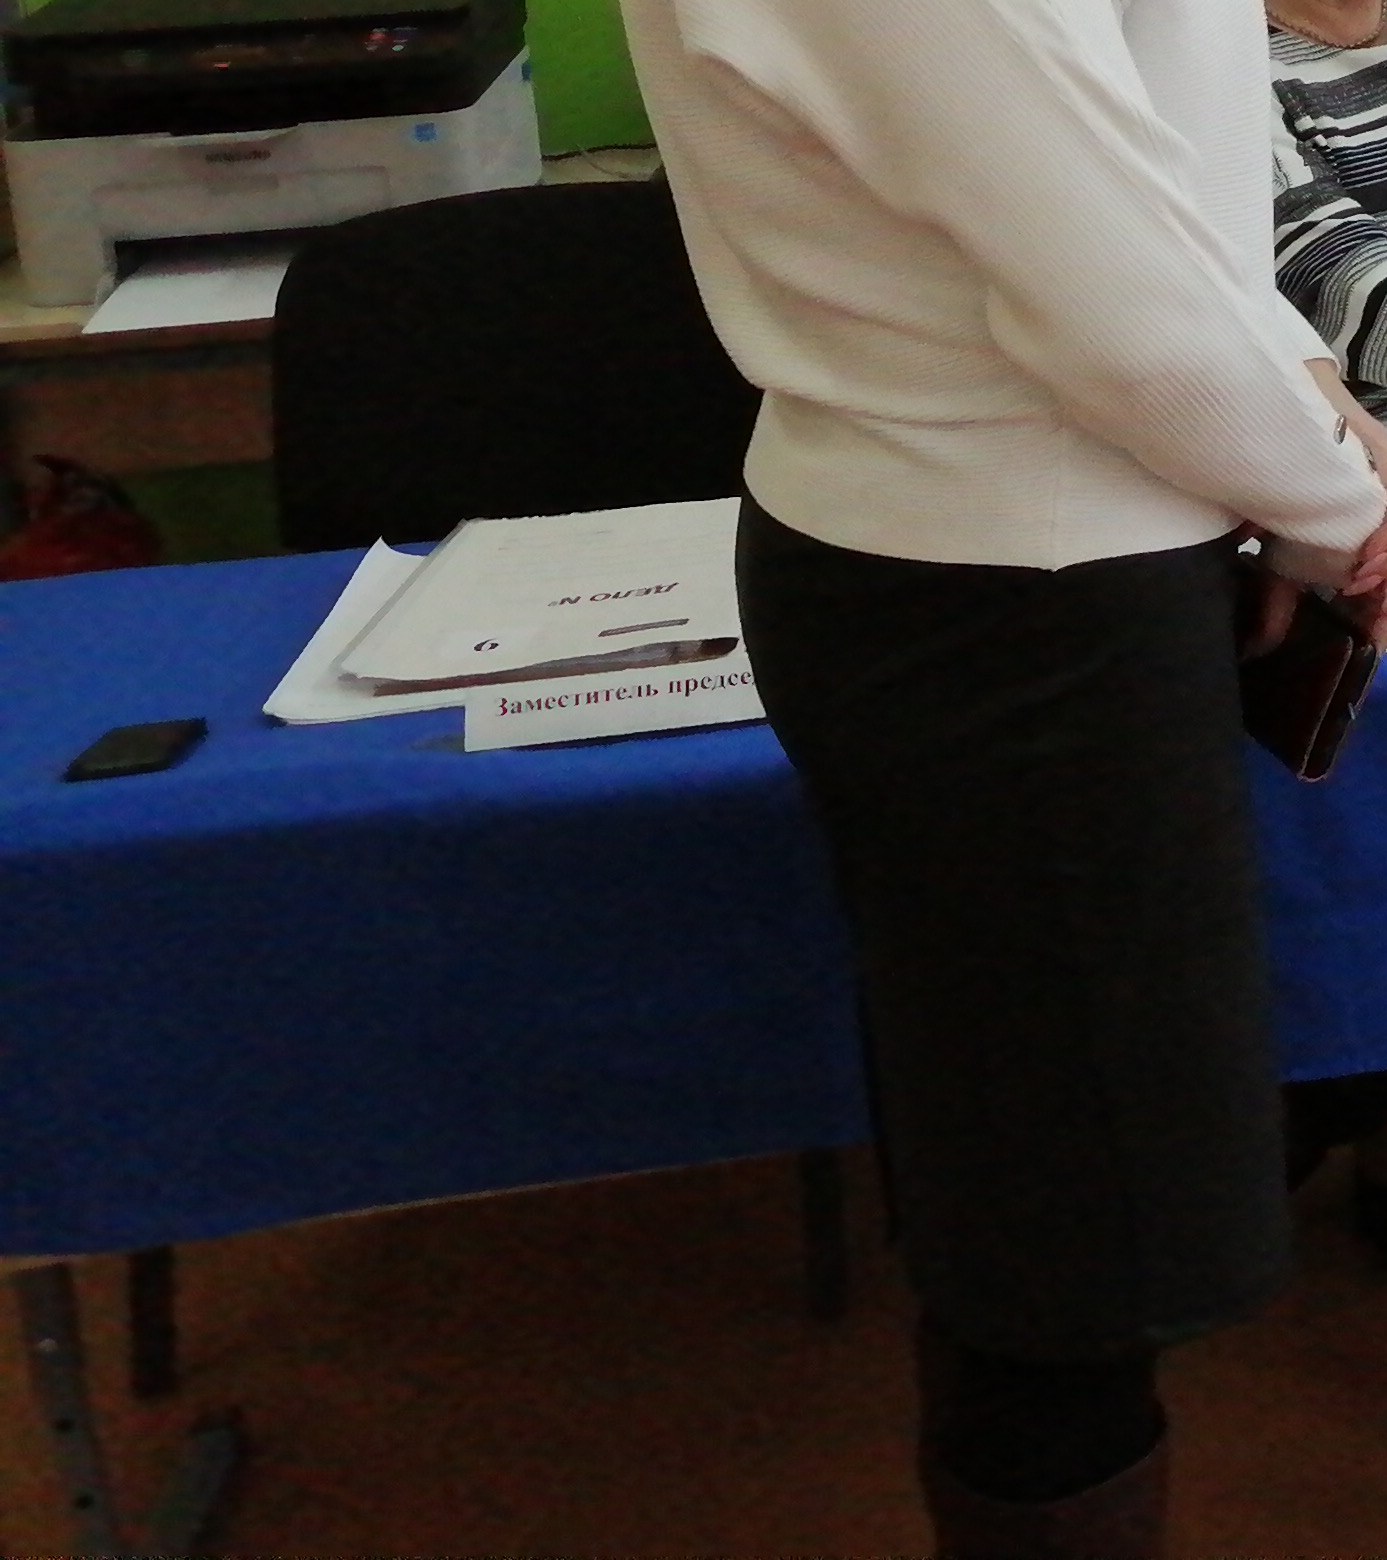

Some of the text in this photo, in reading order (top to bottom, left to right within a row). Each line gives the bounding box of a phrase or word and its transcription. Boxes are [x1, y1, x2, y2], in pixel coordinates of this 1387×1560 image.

[590, 582, 679, 602] ДЕЛО
[495, 671, 755, 716] Заместитель предсе
